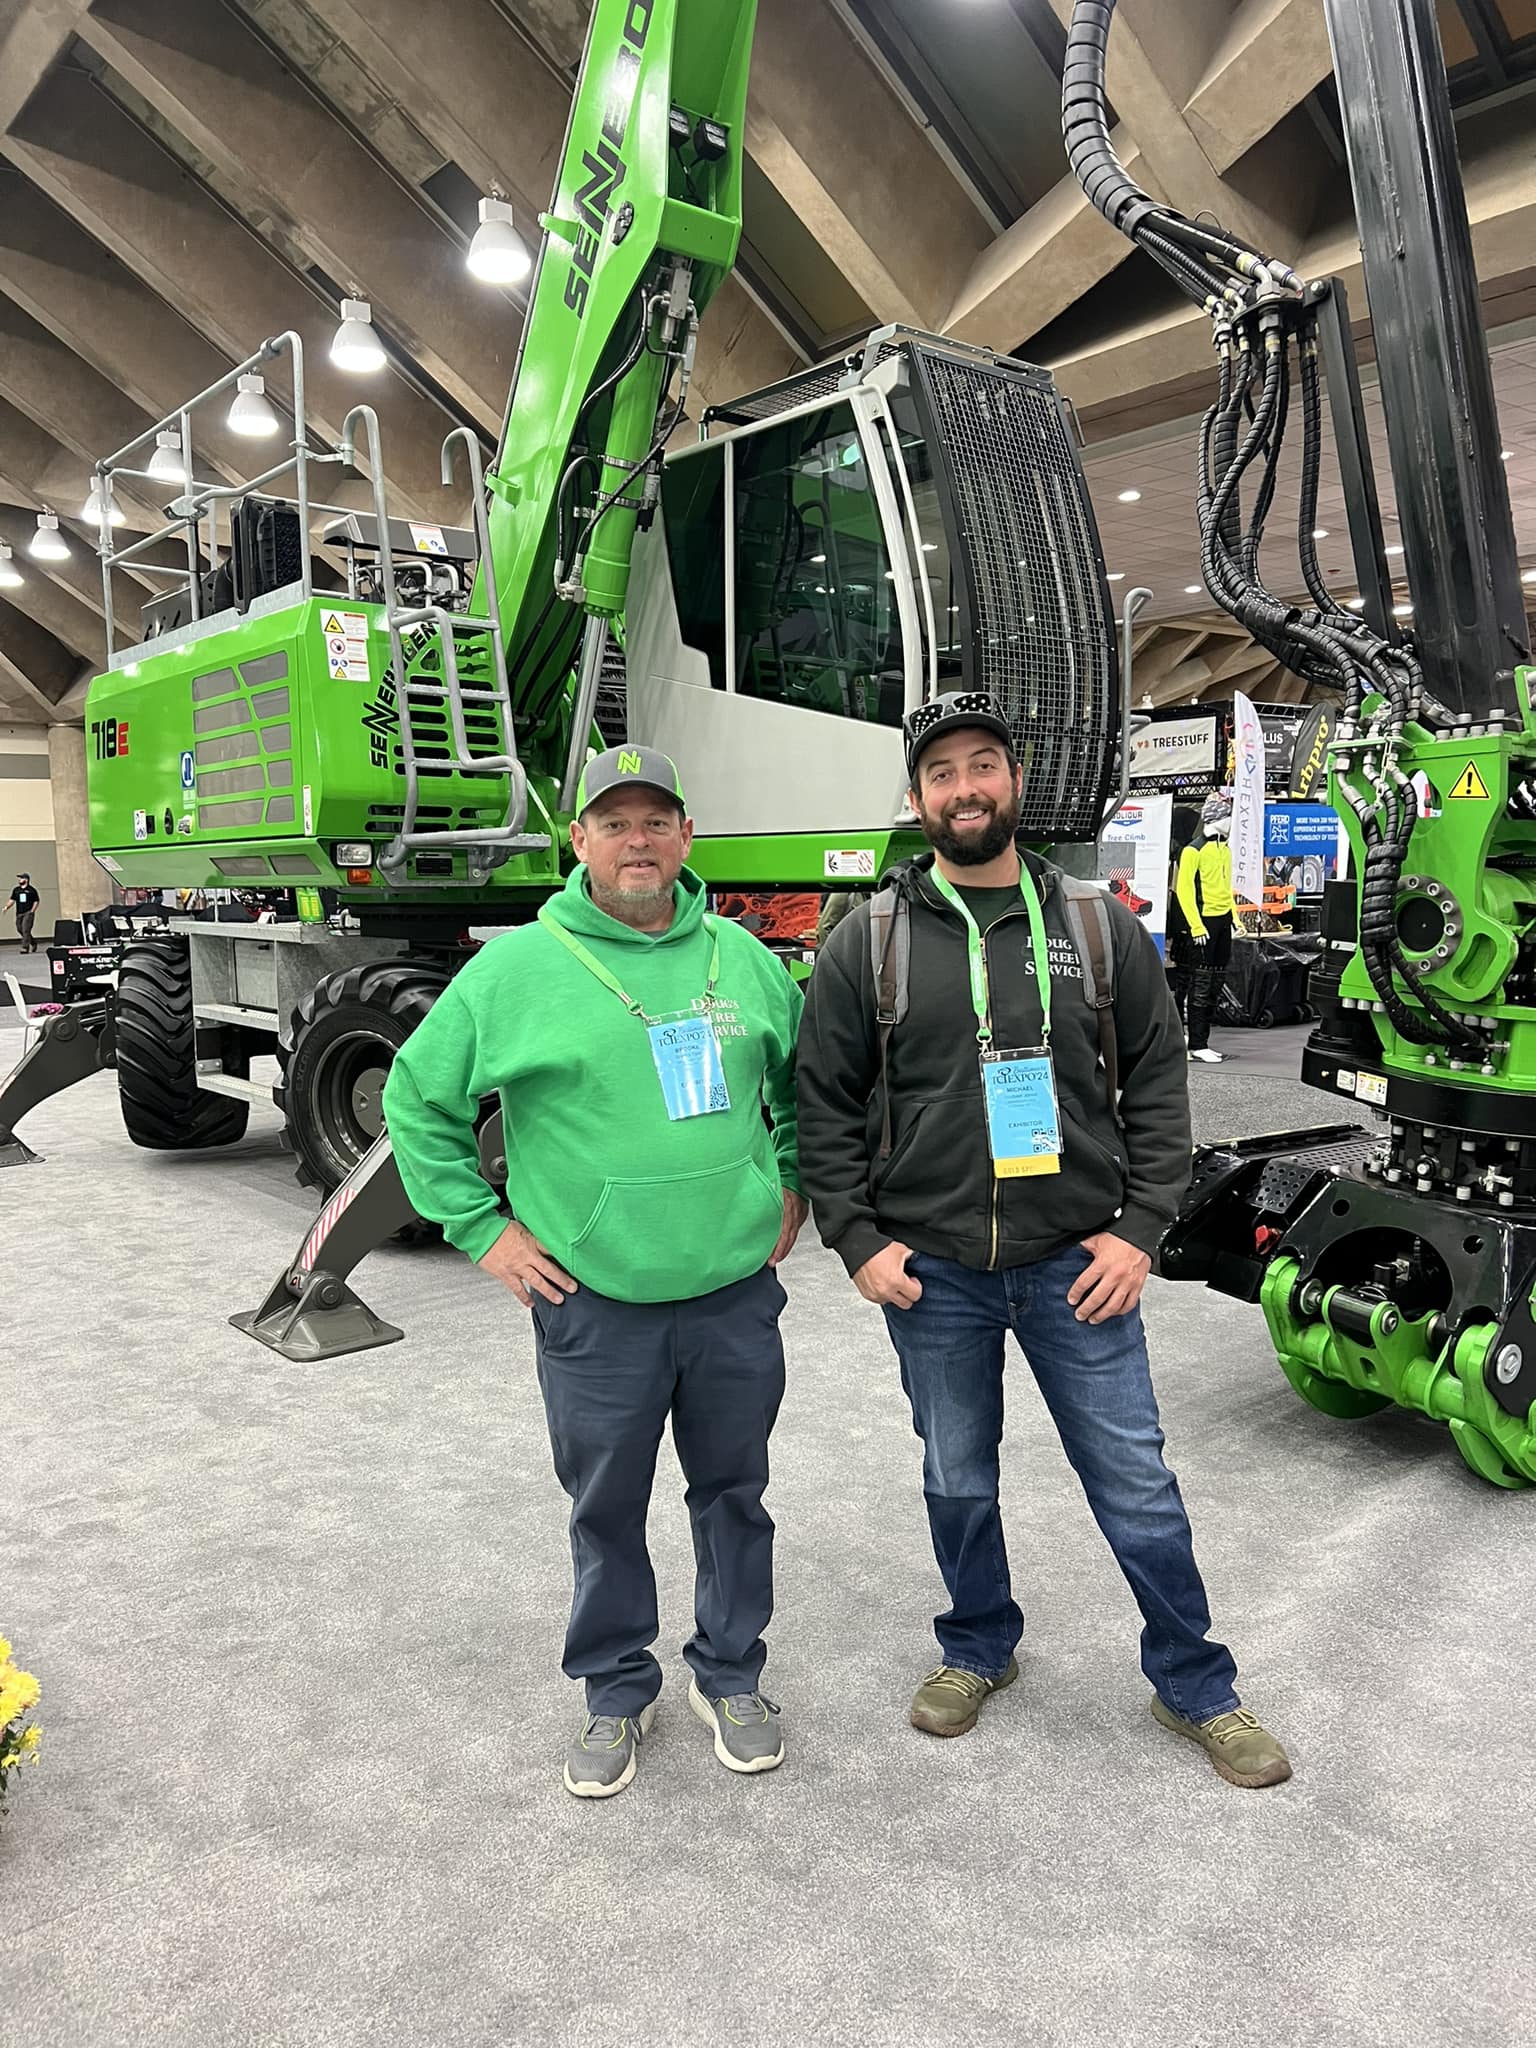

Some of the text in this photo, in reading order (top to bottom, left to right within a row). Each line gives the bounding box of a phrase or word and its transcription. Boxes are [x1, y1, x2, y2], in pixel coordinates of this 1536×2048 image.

[91, 717, 129, 760] 718E
[1153, 733, 1209, 748] TREESTUFF
[1025, 961, 1084, 979] SRVICE
[690, 998, 740, 1011] DUG'S
[1008, 1120, 1043, 1129] EXHIBITOR
